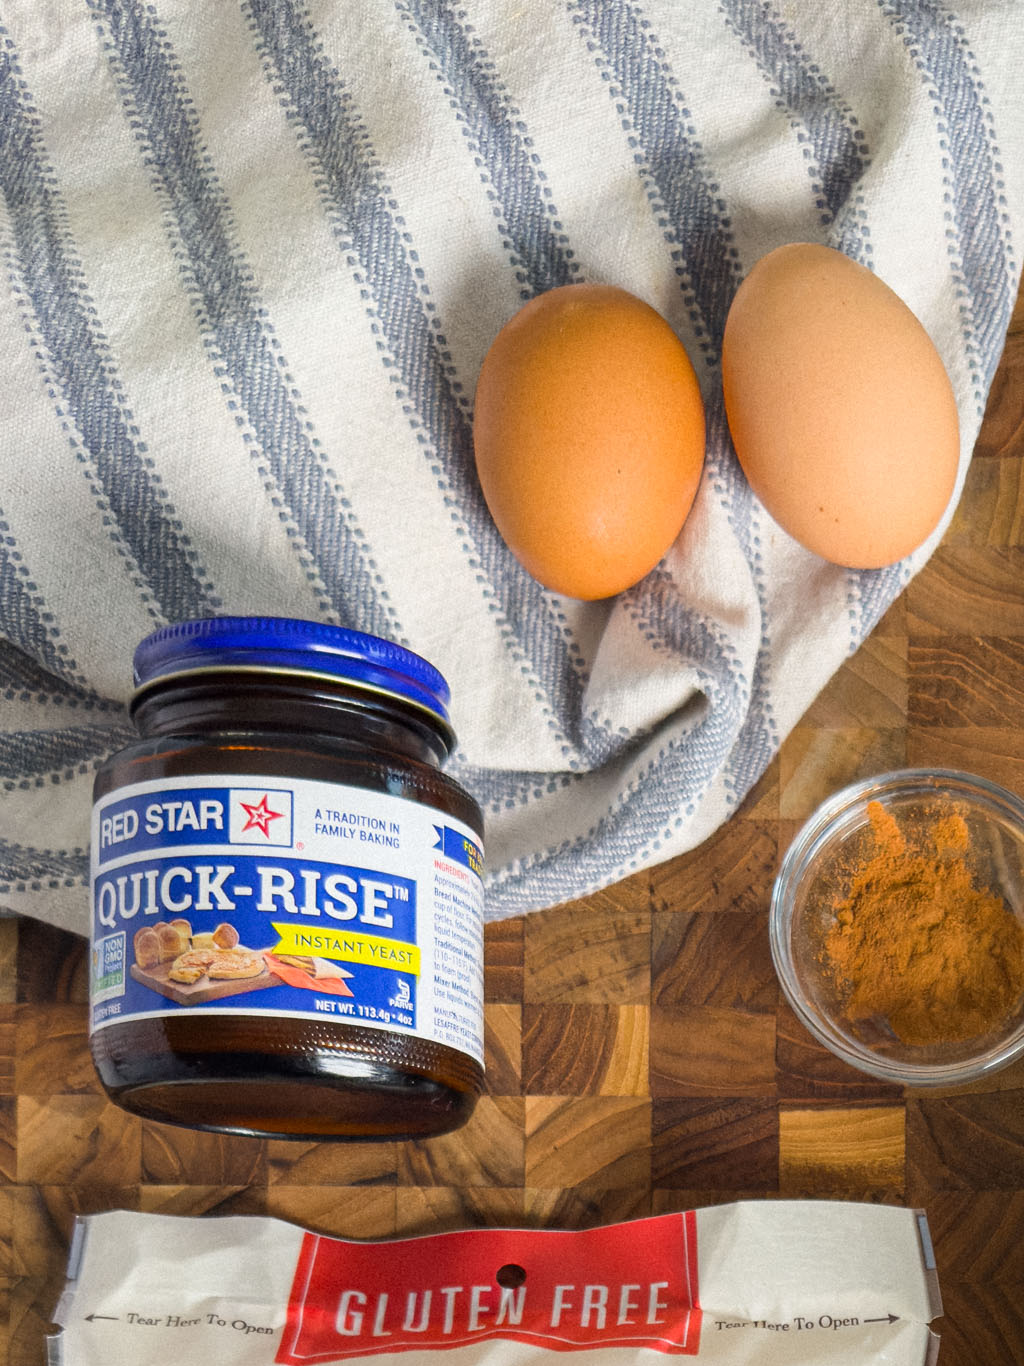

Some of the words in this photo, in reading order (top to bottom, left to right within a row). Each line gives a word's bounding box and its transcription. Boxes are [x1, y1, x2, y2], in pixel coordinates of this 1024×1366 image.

[101, 809, 139, 849] RED
[145, 800, 225, 834] STAR
[314, 808, 323, 820] A
[325, 809, 387, 833] TRADITION
[389, 822, 401, 835] IN
[314, 823, 356, 841] FAMILY
[359, 830, 401, 850] BAKING
[104, 937, 124, 953] NON
[104, 949, 124, 965] GMO
[293, 932, 363, 956] INSTANT
[368, 940, 414, 966] YEAST
[315, 999, 337, 1013] NET
[338, 1002, 357, 1016] WT.
[358, 1005, 391, 1024] 113.4g
[397, 1012, 413, 1026] 4oz
[388, 997, 415, 1012] PARVE
[335, 1285, 527, 1338] GLUTEN
[550, 1281, 670, 1331] FREE
[127, 1312, 162, 1328] Tear
[166, 1315, 202, 1329] Here
[206, 1313, 227, 1327] To
[231, 1319, 274, 1336] Open
[753, 1320, 790, 1333] Here
[794, 1317, 815, 1331] To
[818, 1314, 860, 1330] Open
